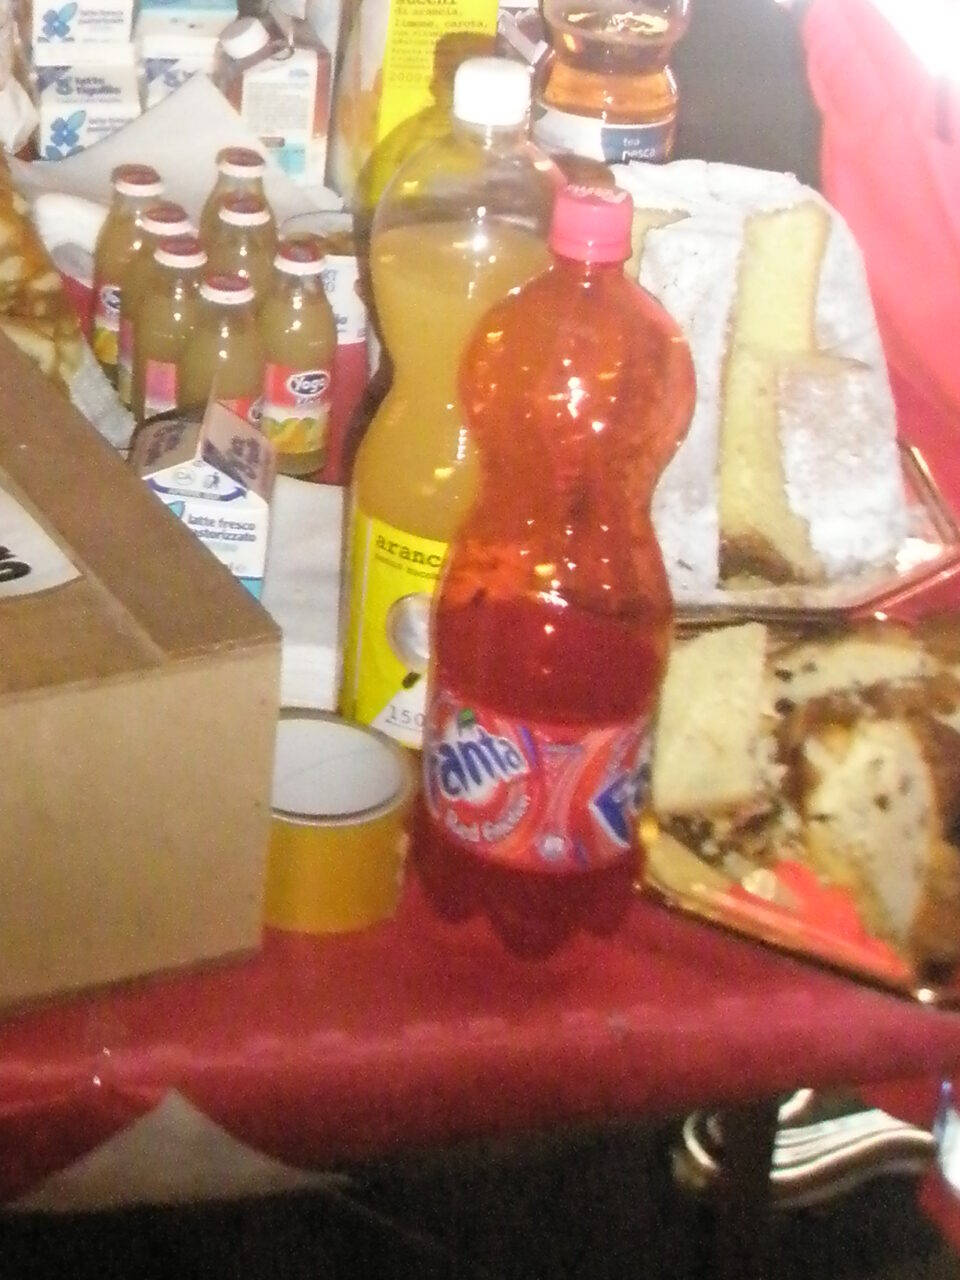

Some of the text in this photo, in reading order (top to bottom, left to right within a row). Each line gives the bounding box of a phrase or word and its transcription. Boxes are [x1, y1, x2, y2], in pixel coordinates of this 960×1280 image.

[188, 515, 256, 531] latte fresco
[375, 534, 441, 567] aranc
[389, 705, 427, 727] 150
